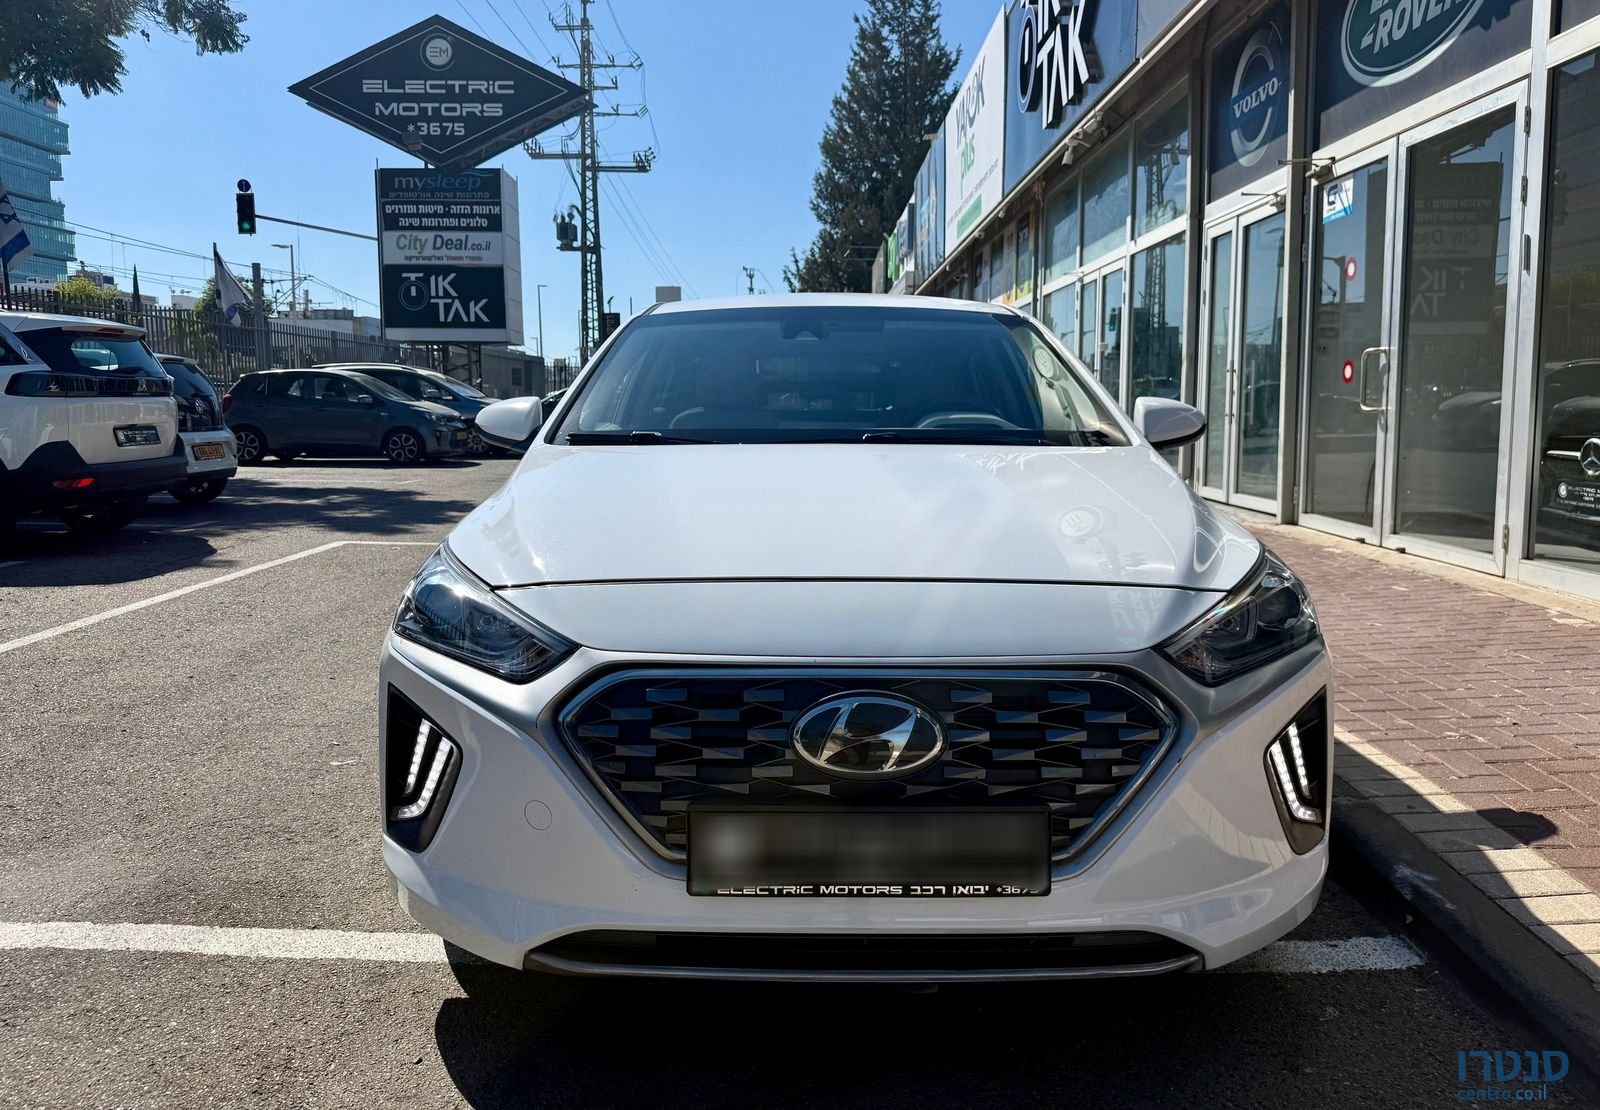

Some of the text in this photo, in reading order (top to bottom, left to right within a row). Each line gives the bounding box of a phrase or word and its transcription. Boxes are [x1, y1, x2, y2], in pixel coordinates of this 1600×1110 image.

[1372, 0, 1463, 54] ROVE
[1036, 0, 1089, 130] TAK
[955, 55, 986, 149] YAROK
[1233, 77, 1278, 118] VOLVO
[375, 102, 503, 117] MOTORS
[394, 174, 481, 191] mysleep
[472, 204, 501, 214] ארונות
[398, 217, 420, 227] שינה
[460, 216, 488, 227] סלונים
[395, 233, 429, 254] City
[401, 272, 459, 297] TIK
[430, 298, 490, 322] TAK
[819, 885, 903, 895] MOTORS
[910, 885, 946, 895] רכב
[952, 885, 989, 895] יבואן
